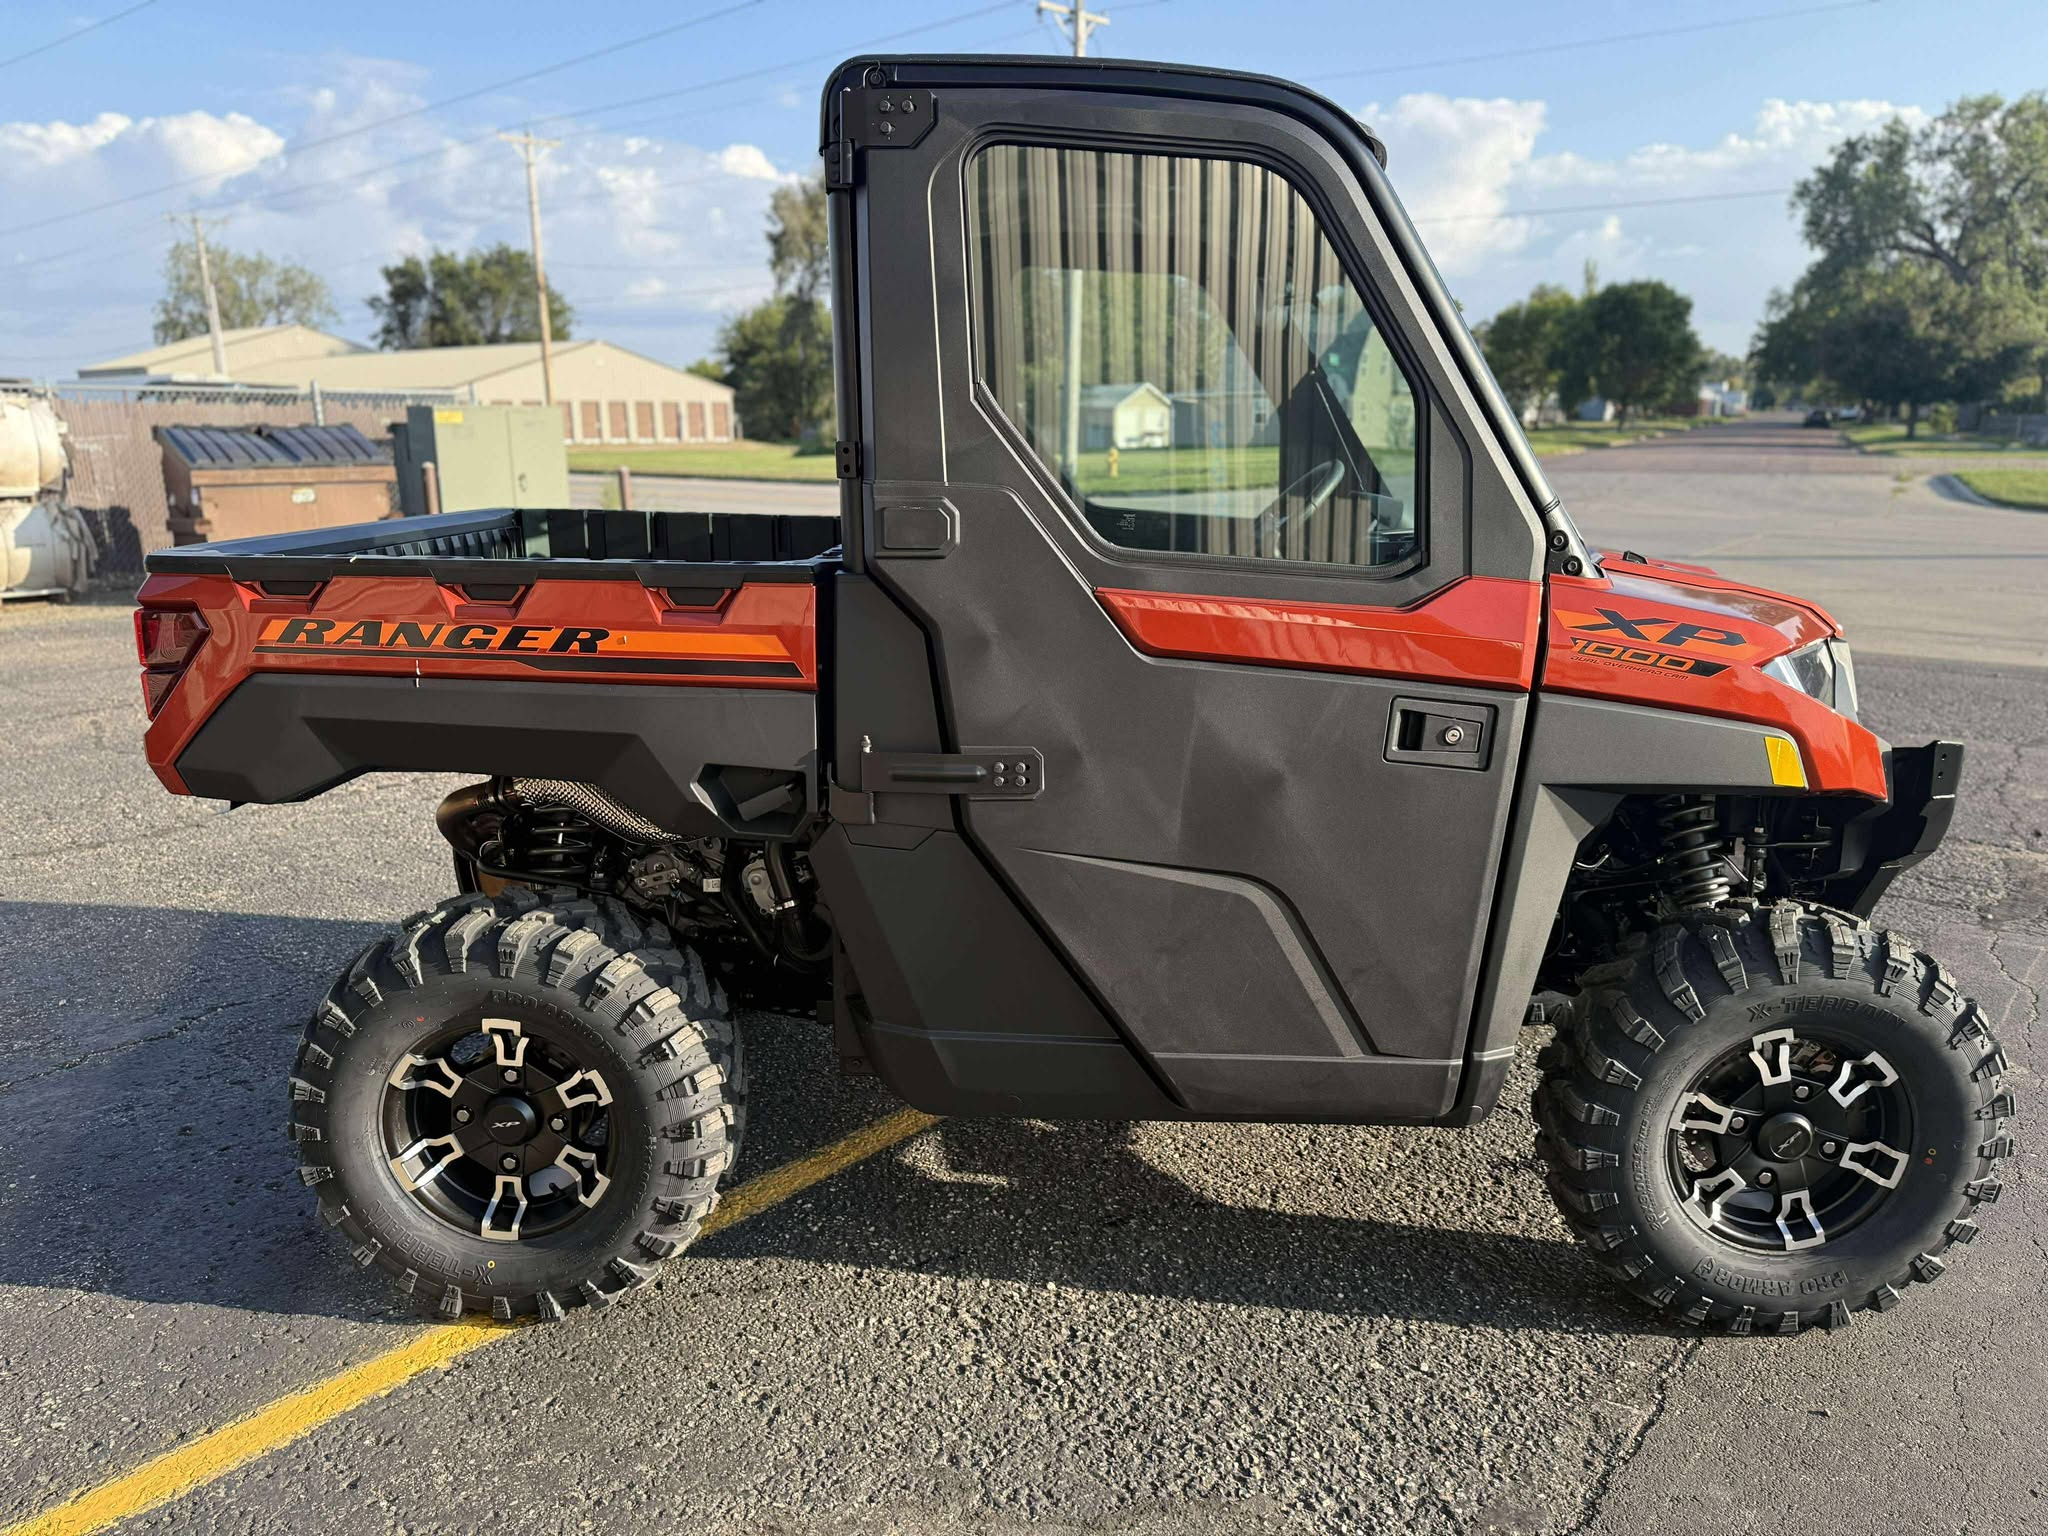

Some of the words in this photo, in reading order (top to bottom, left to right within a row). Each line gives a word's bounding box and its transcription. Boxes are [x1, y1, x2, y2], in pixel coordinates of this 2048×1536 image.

[276, 617, 610, 654] RANGER
[1567, 607, 1747, 647] XP
[1570, 656, 1600, 665] DUAL
[1603, 661, 1664, 676] OVERHEAD
[1664, 671, 1689, 681] CAM
[1573, 640, 1696, 672] 1000
[1747, 995, 1908, 1028] X-TERRAIN
[491, 1121, 521, 1129] XP
[362, 1199, 494, 1286] X-TERRAIN
[1713, 1267, 1797, 1297] ARMOR
[1801, 1270, 1849, 1296] PRO
